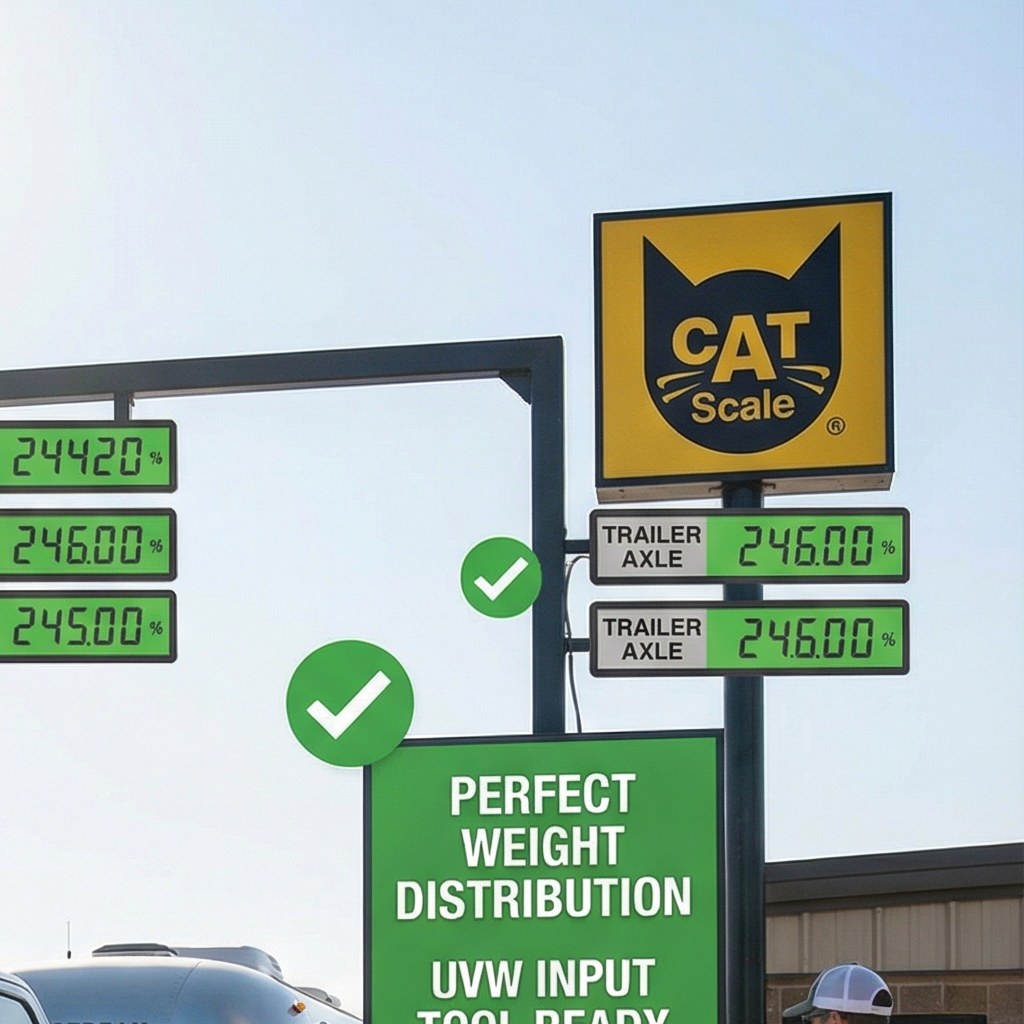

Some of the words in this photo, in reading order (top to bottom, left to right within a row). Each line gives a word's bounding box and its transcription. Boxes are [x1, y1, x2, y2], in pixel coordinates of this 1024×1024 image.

[672, 311, 810, 383] CAT
[691, 388, 795, 424] Scale
[12, 436, 143, 477] 24420
[13, 525, 143, 565] 246.00
[601, 525, 702, 544] TRAILER
[738, 525, 874, 567] 246.00
[621, 549, 683, 568] AXLE
[12, 606, 143, 647] 245.00
[602, 618, 702, 637] TRAILER
[621, 641, 683, 661] AXLE
[450, 772, 637, 816] PERFECT
[461, 825, 626, 867] WEIGHT
[396, 876, 692, 920] DISTRIBUTION
[432, 959, 523, 999] UVW
[537, 958, 657, 998] INPUT
